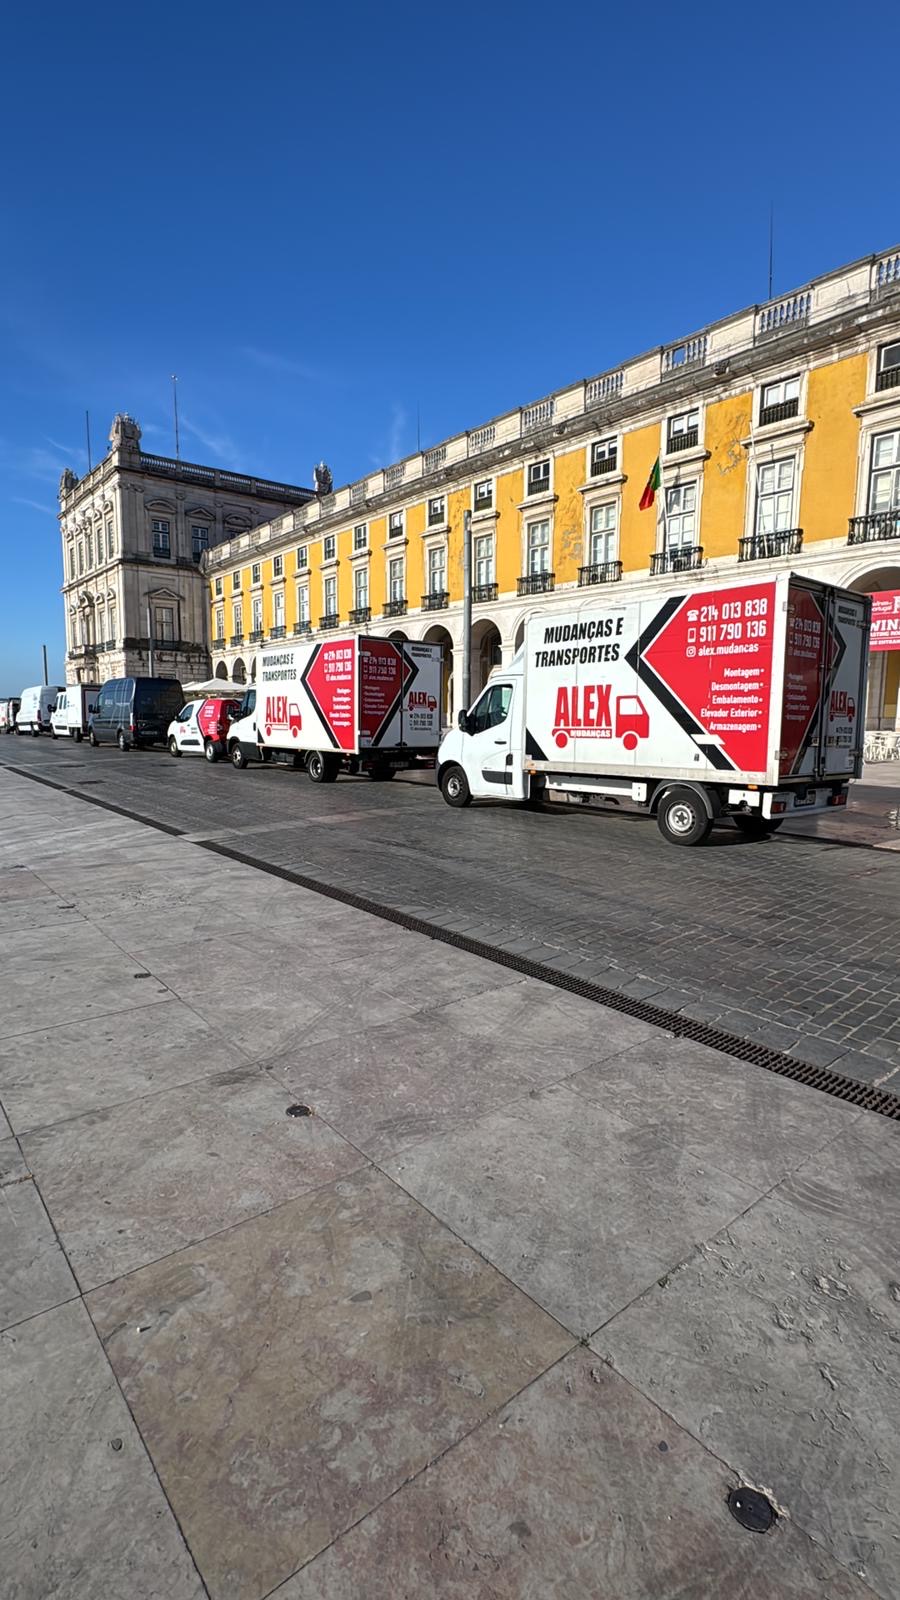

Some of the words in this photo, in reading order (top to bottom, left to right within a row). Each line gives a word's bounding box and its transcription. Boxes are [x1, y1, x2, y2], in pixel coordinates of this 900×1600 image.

[700, 605, 719, 622] 214
[722, 601, 741, 619] 013
[744, 598, 768, 617] 838
[543, 618, 613, 644] MUDANÇAS
[615, 617, 624, 636] E
[699, 625, 717, 642] 911
[720, 622, 742, 641] 790
[746, 620, 767, 638] 136
[535, 643, 620, 668] TRANSPORTES
[262, 669, 297, 682] TRANSPORTES
[723, 668, 760, 678] Montagem
[711, 682, 759, 692] Desmontagem
[554, 684, 612, 727] ALEX
[712, 695, 759, 704] Embalamento
[265, 696, 288, 723] ALEX
[701, 708, 729, 717] Elevador
[730, 708, 758, 717] Exterior
[709, 721, 757, 733] Armazenagem
[570, 730, 611, 738] MUDANÇAS
